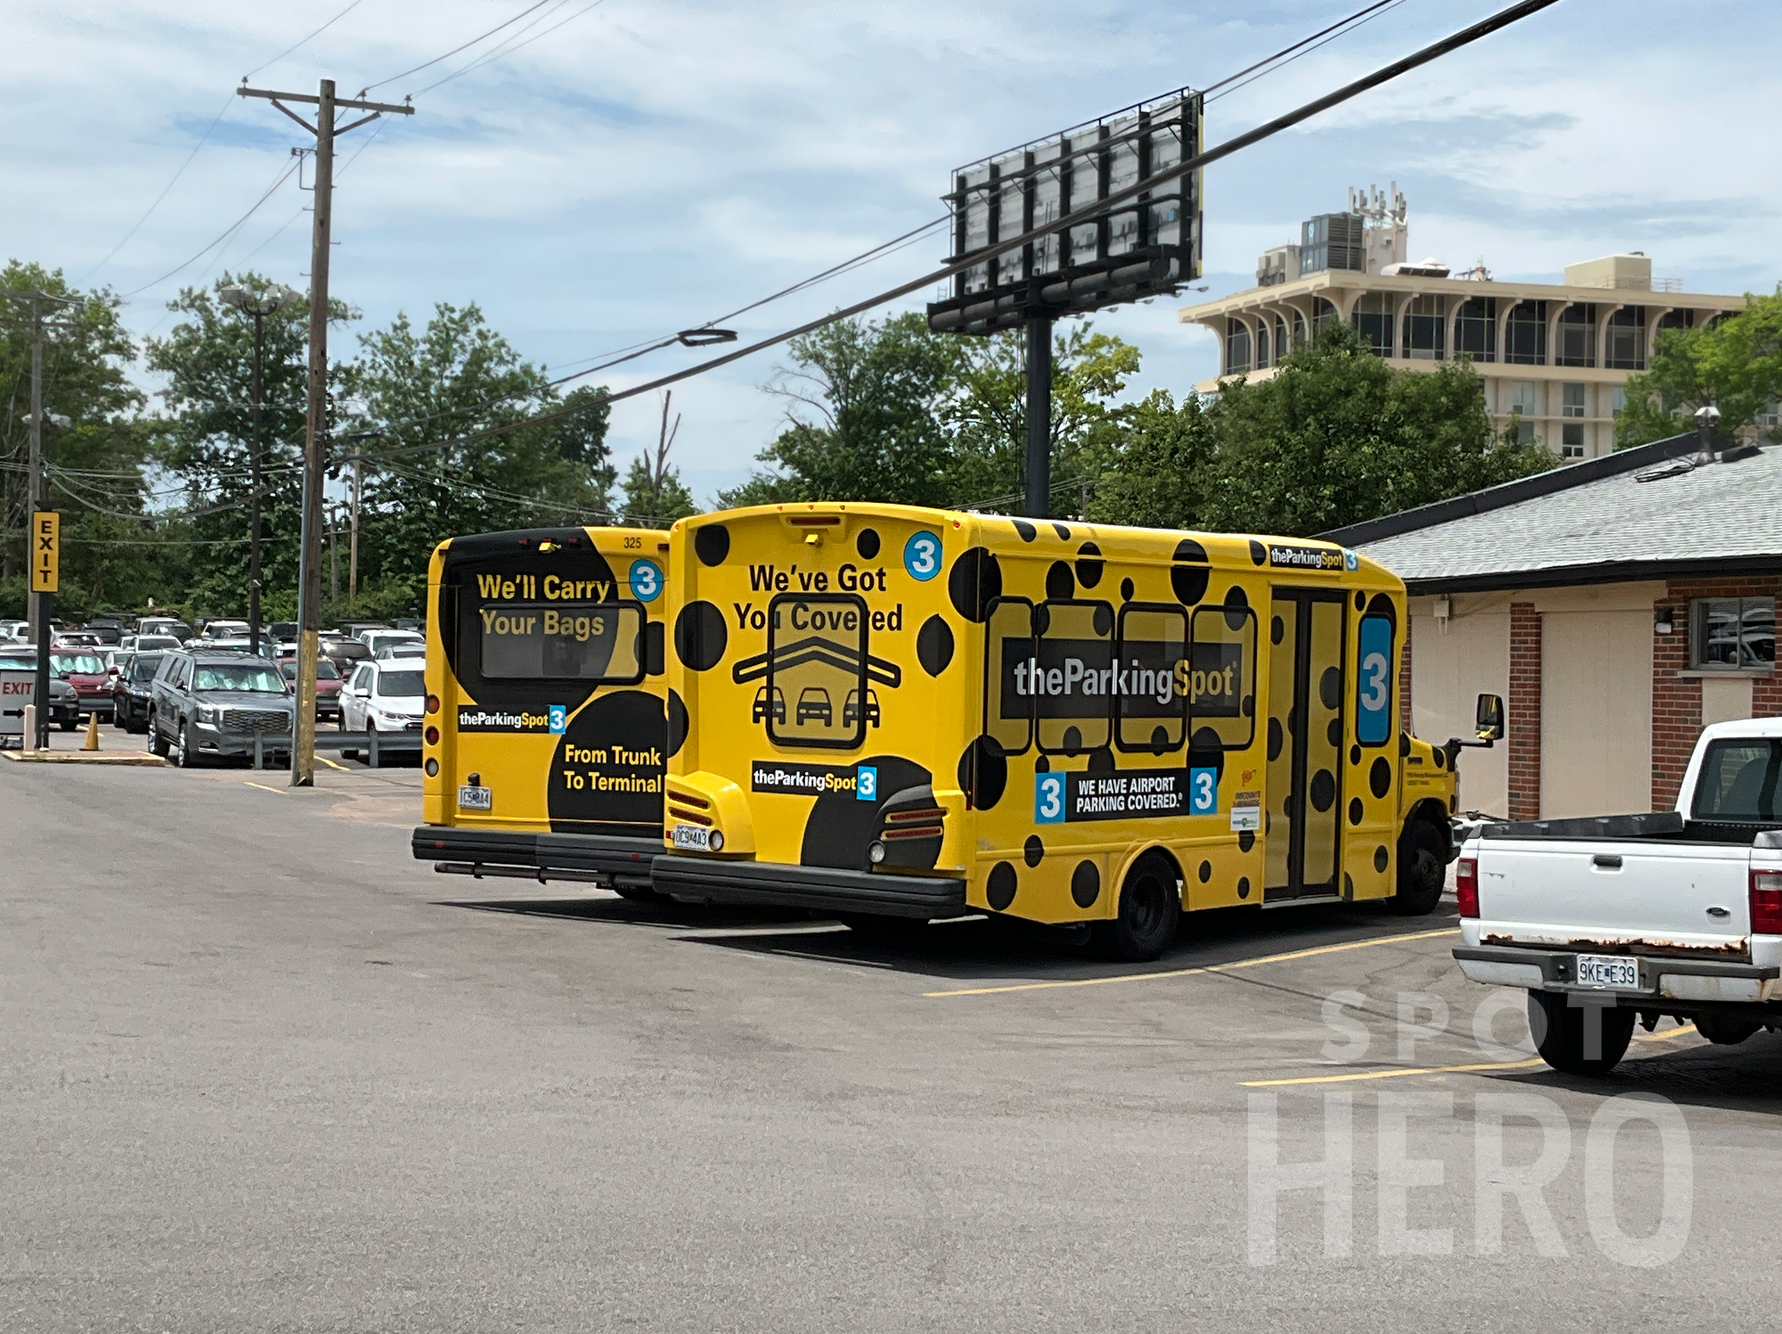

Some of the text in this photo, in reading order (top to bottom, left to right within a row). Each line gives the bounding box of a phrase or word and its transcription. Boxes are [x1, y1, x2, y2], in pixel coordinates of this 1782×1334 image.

[40, 520, 53, 584] EXIT
[623, 537, 642, 549] 325
[912, 539, 934, 572] 3
[1270, 548, 1357, 568] theParkingSpot 3
[543, 575, 610, 604] Carry
[636, 565, 656, 594] 3
[838, 564, 887, 591] Got
[479, 608, 604, 641] Your Bags
[2, 682, 34, 695] EXIT
[1361, 652, 1387, 711] 3
[459, 711, 564, 730] theParkingSpot 3
[565, 744, 661, 766] From Trunk
[564, 770, 662, 793] To Terminal
[753, 769, 874, 795] theParkingSpot 3
[1078, 777, 1175, 793] WE HAVE AIRPORT
[1195, 773, 1212, 810] 3
[1040, 778, 1060, 818] 3
[1076, 797, 1124, 812] PARKING
